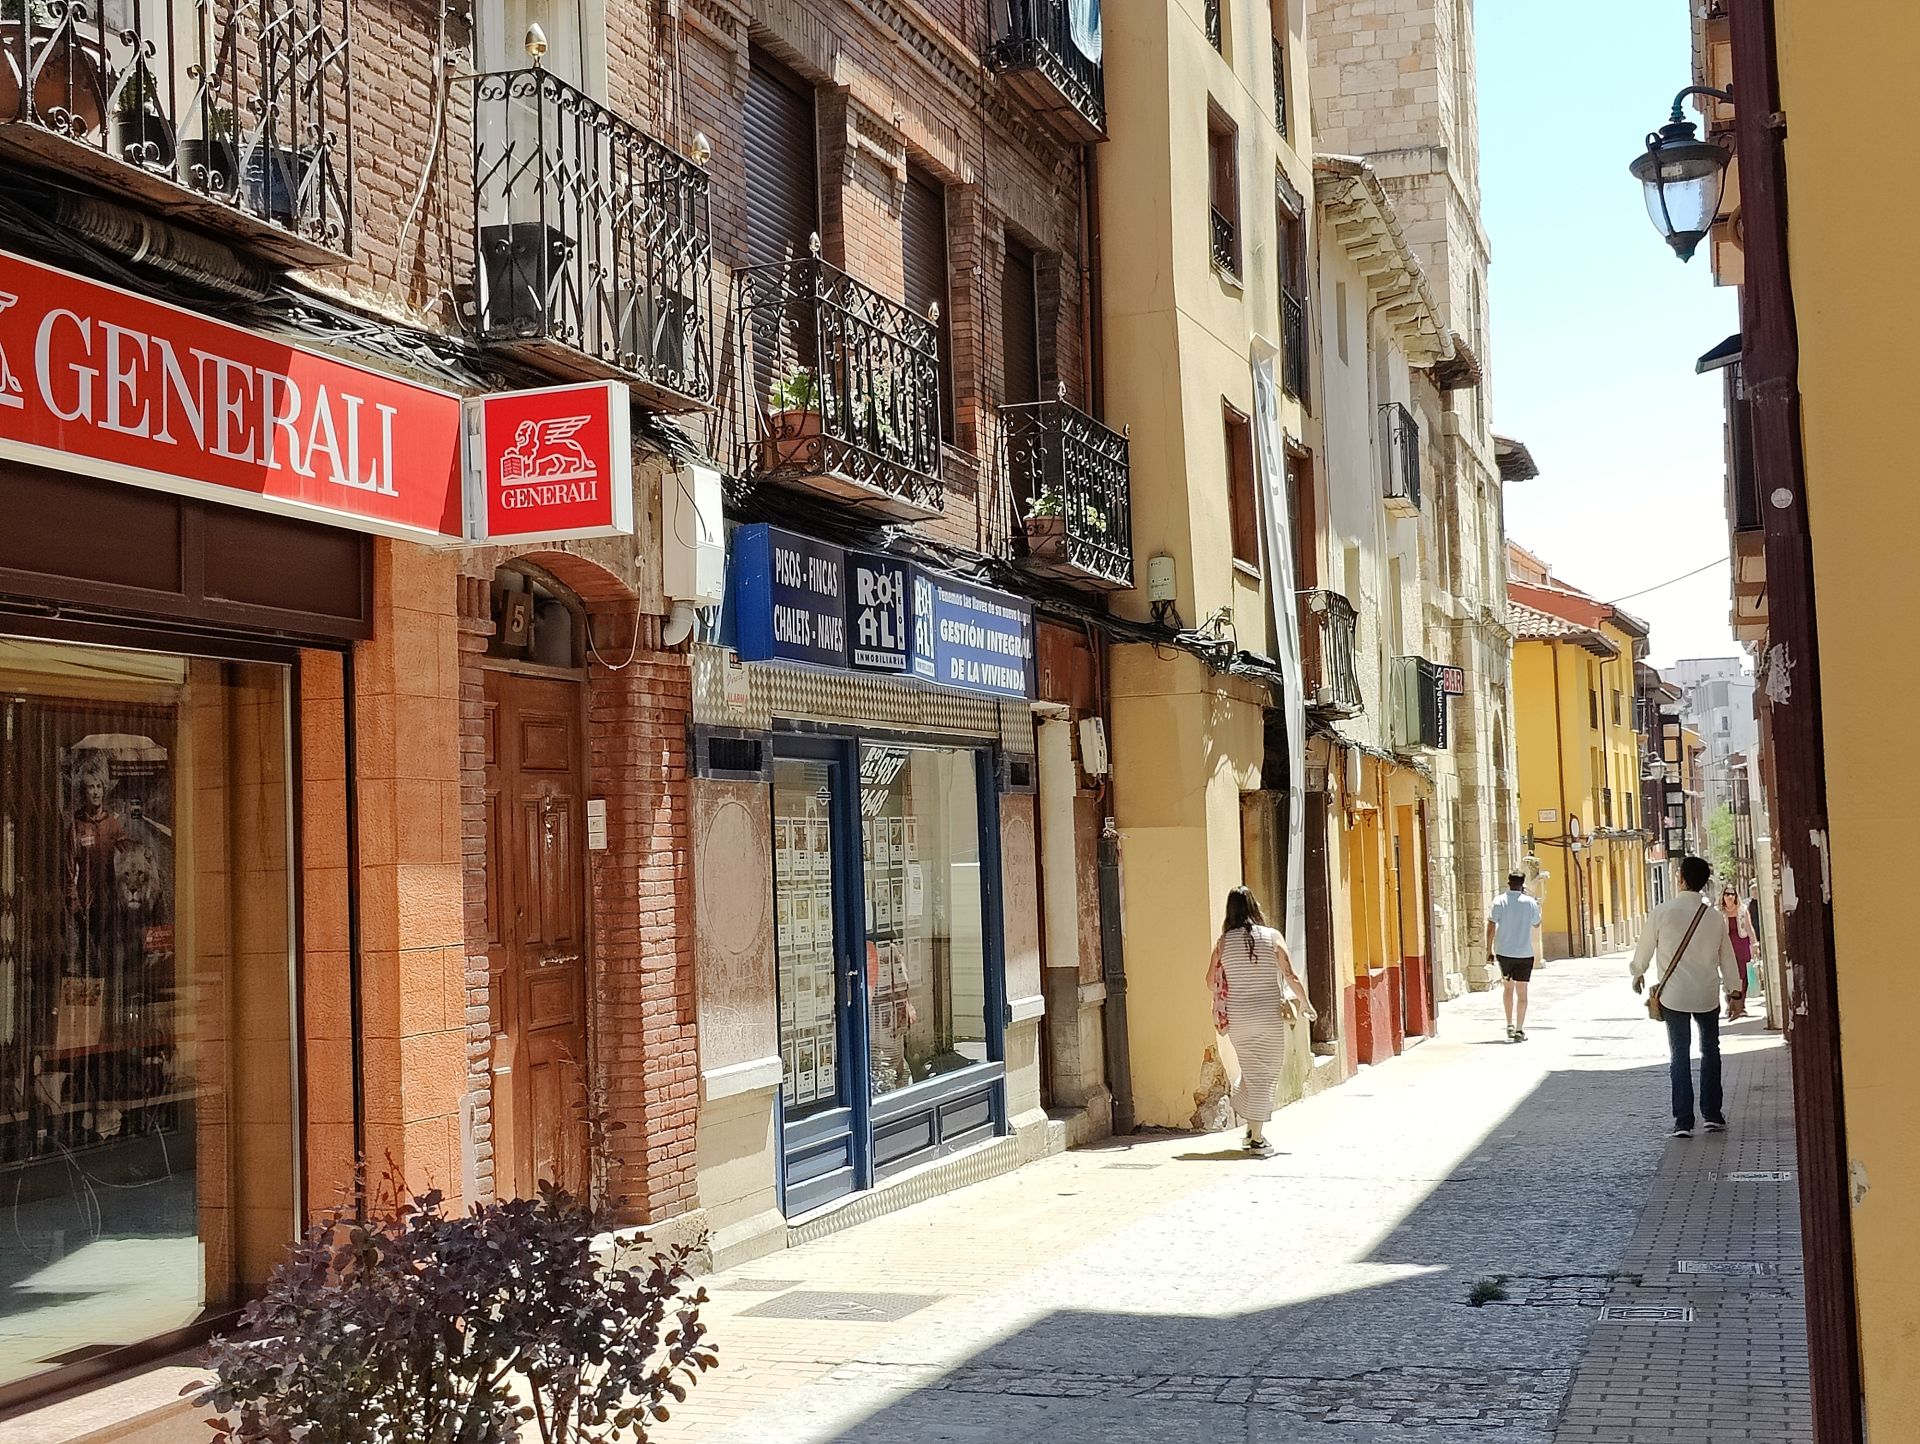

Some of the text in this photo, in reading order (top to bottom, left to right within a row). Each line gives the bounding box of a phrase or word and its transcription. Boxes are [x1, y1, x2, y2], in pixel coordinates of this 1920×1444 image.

[34, 308, 399, 497] GENERALI
[501, 481, 598, 509] GENERALI
[775, 548, 801, 589] PISOS
[808, 556, 838, 597] FINCAS
[512, 605, 525, 633] 5
[773, 604, 810, 647] CHALETS
[817, 613, 843, 652] NAVES
[940, 619, 1032, 660] GESTIÓN INTEGRAL
[857, 652, 905, 666] INMOBILIARIA
[950, 657, 965, 681] DE
[967, 660, 980, 683] LA
[981, 662, 1026, 692] VIVIENDA
[1443, 668, 1463, 693] BAR
[873, 756, 906, 785] 987
